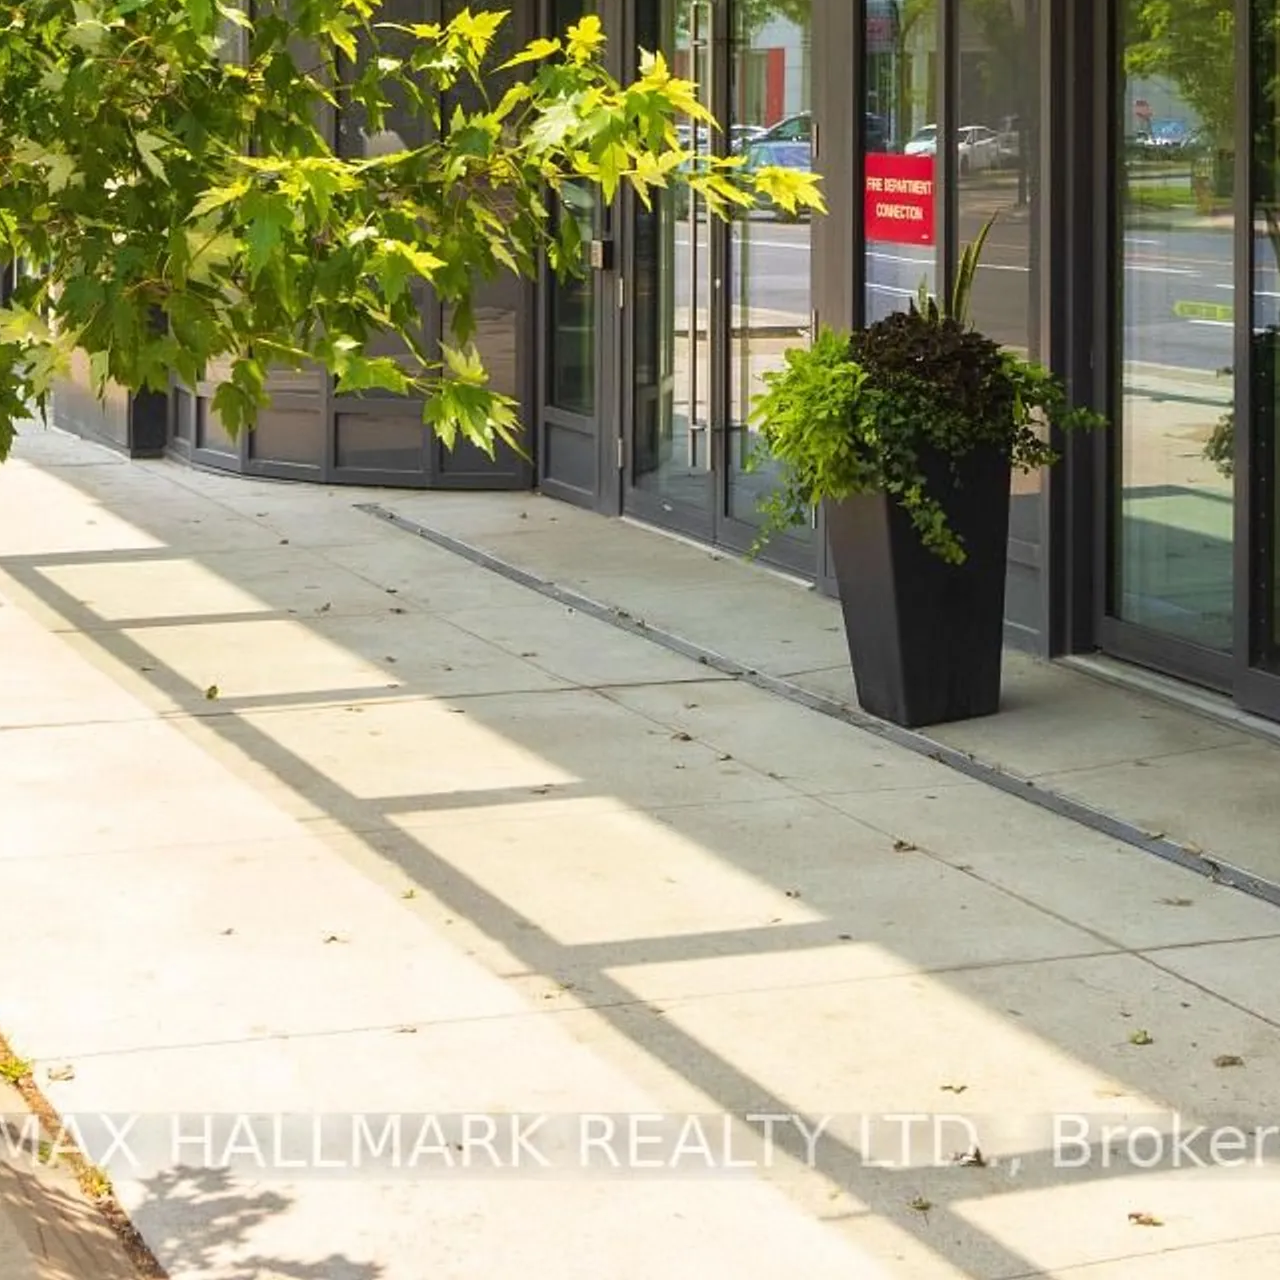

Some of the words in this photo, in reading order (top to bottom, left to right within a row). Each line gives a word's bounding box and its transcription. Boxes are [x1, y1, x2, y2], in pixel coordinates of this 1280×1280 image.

[866, 176, 883, 192] FIRE
[884, 177, 932, 196] DEPARTMENT
[876, 203, 923, 221] CONNECTION
